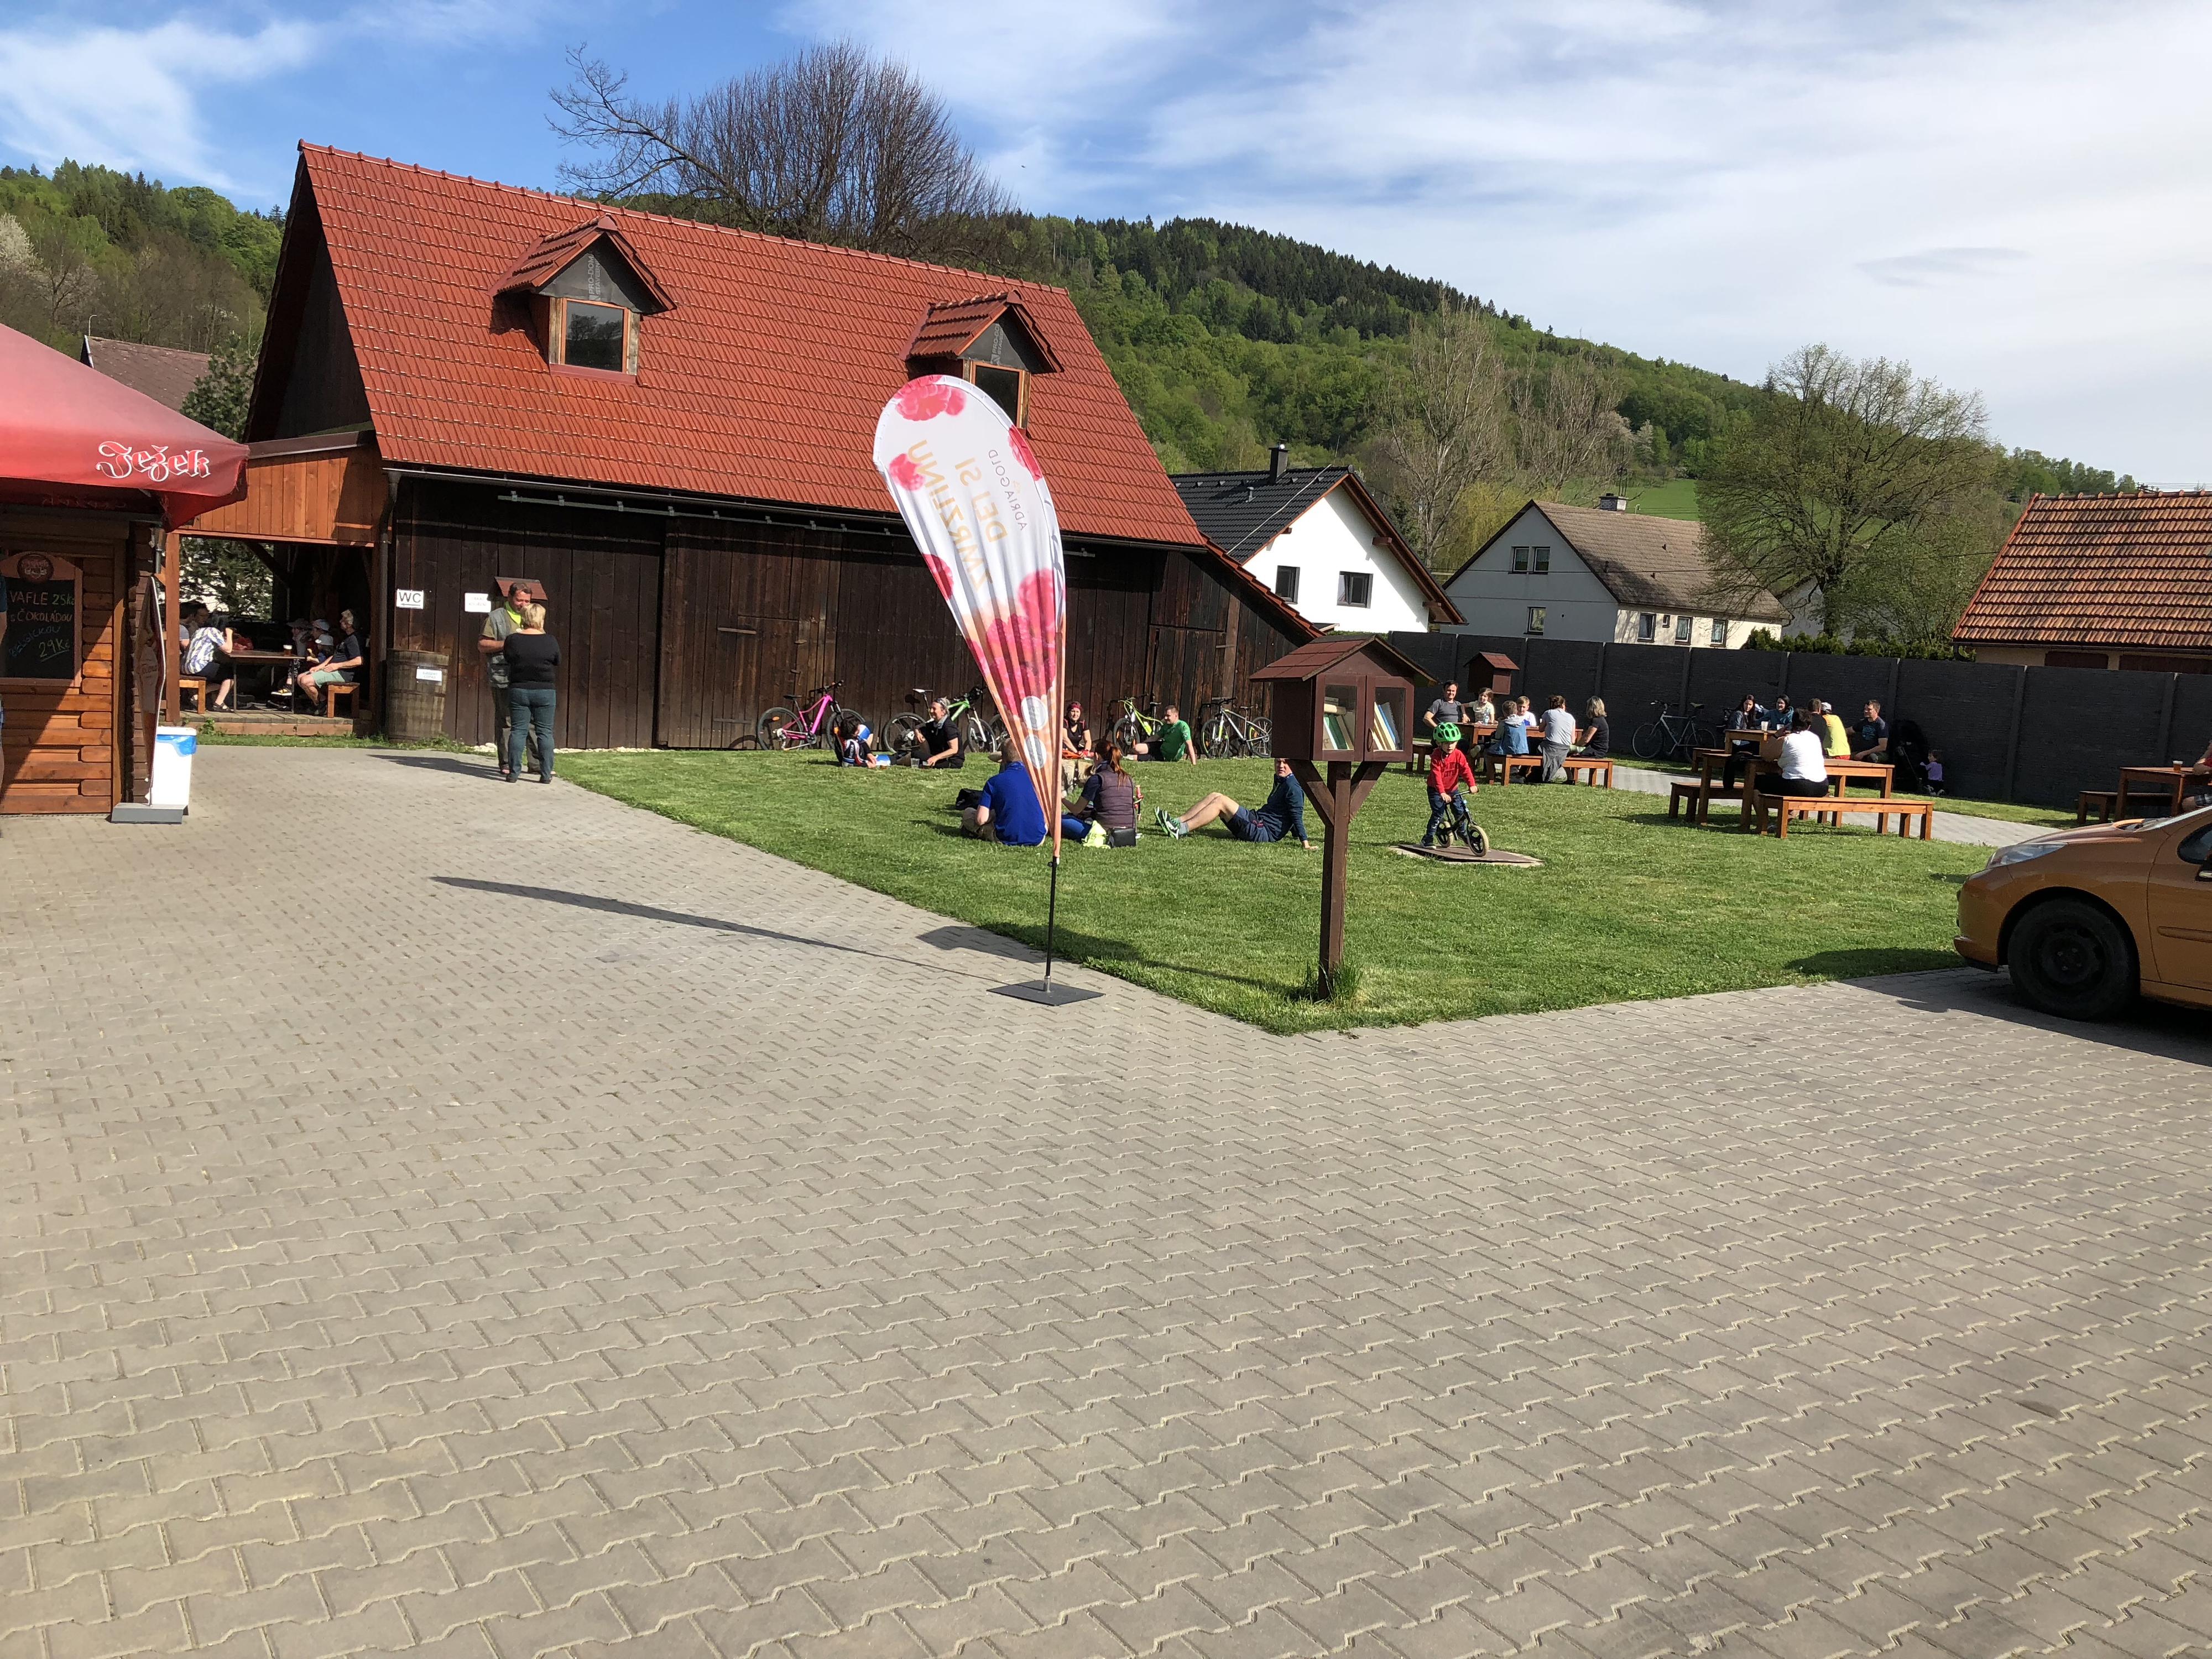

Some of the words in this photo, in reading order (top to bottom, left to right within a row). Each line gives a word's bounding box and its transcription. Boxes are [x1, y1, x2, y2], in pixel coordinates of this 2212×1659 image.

[95, 441, 211, 482] Ježek
[9, 592, 49, 606] VAFLE
[399, 592, 421, 603] WC
